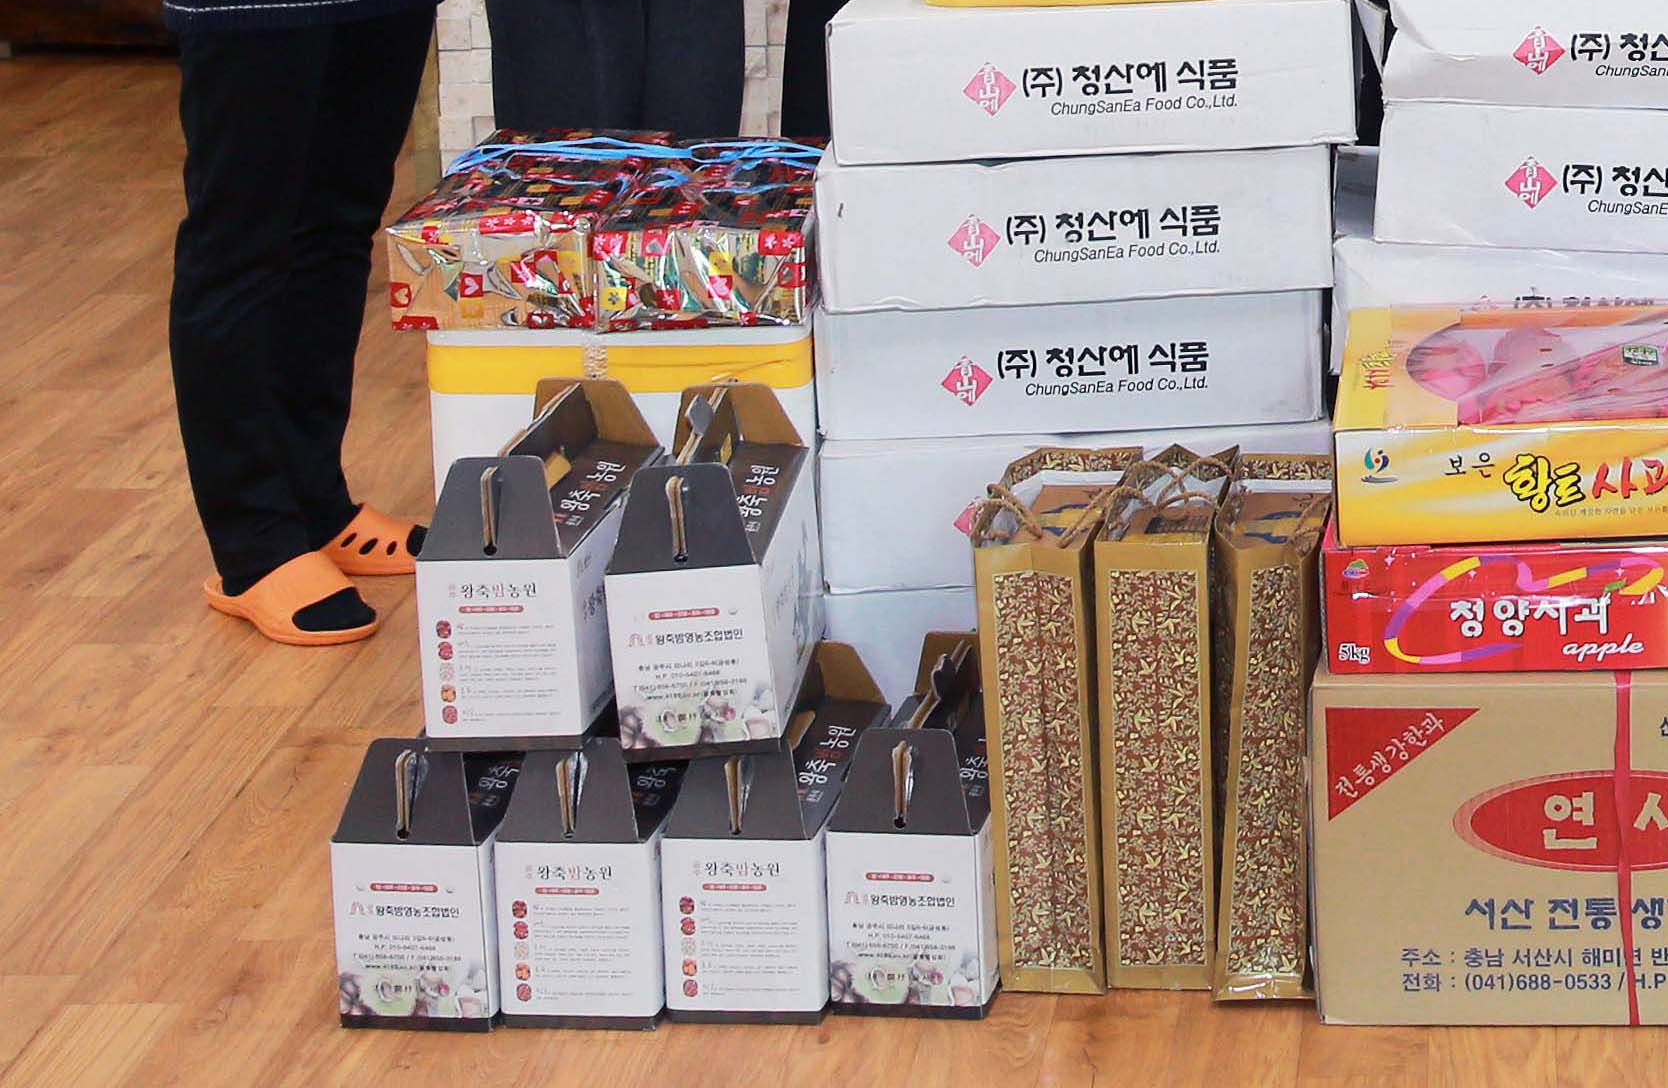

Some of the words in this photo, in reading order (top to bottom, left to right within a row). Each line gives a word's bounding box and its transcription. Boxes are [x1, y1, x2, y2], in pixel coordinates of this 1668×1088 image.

[1570, 33, 1611, 61] (주)
[1022, 67, 1062, 98] (주)
[1071, 62, 1167, 96] 청산에
[1175, 58, 1239, 91] 식품
[1050, 98, 1142, 116] ChungSanEa
[1145, 96, 1182, 111] Food
[1186, 94, 1239, 110] Co.,Ltd.
[1562, 164, 1603, 194] (주)
[1006, 214, 1047, 245] (주)
[1055, 208, 1150, 243] 청산에
[1159, 204, 1221, 238] 식품
[1034, 245, 1125, 263] ChungSanEa
[1128, 243, 1165, 258] Food
[1168, 240, 1221, 256] Co.,Ltd.
[997, 348, 1037, 379] (주)
[1046, 344, 1140, 378] 청산에
[1148, 342, 1209, 373] 식품
[1025, 380, 1115, 397] ChungSanEa
[1117, 379, 1154, 393] Food
[1157, 376, 1209, 391] Co.,Ltd.
[1444, 452, 1496, 479] 보은
[1338, 643, 1371, 663] 5kg
[1562, 633, 1646, 663] apple
[1335, 712, 1446, 799] 전통생강한과
[1464, 898, 1535, 930] 서산
[1547, 897, 1618, 930] 전통
[1401, 947, 1442, 967] 주소
[1464, 947, 1505, 968] 충남
[1512, 947, 1573, 968] 서산시
[1402, 973, 1442, 993] 전화
[1464, 972, 1612, 992] (041)688-0533
